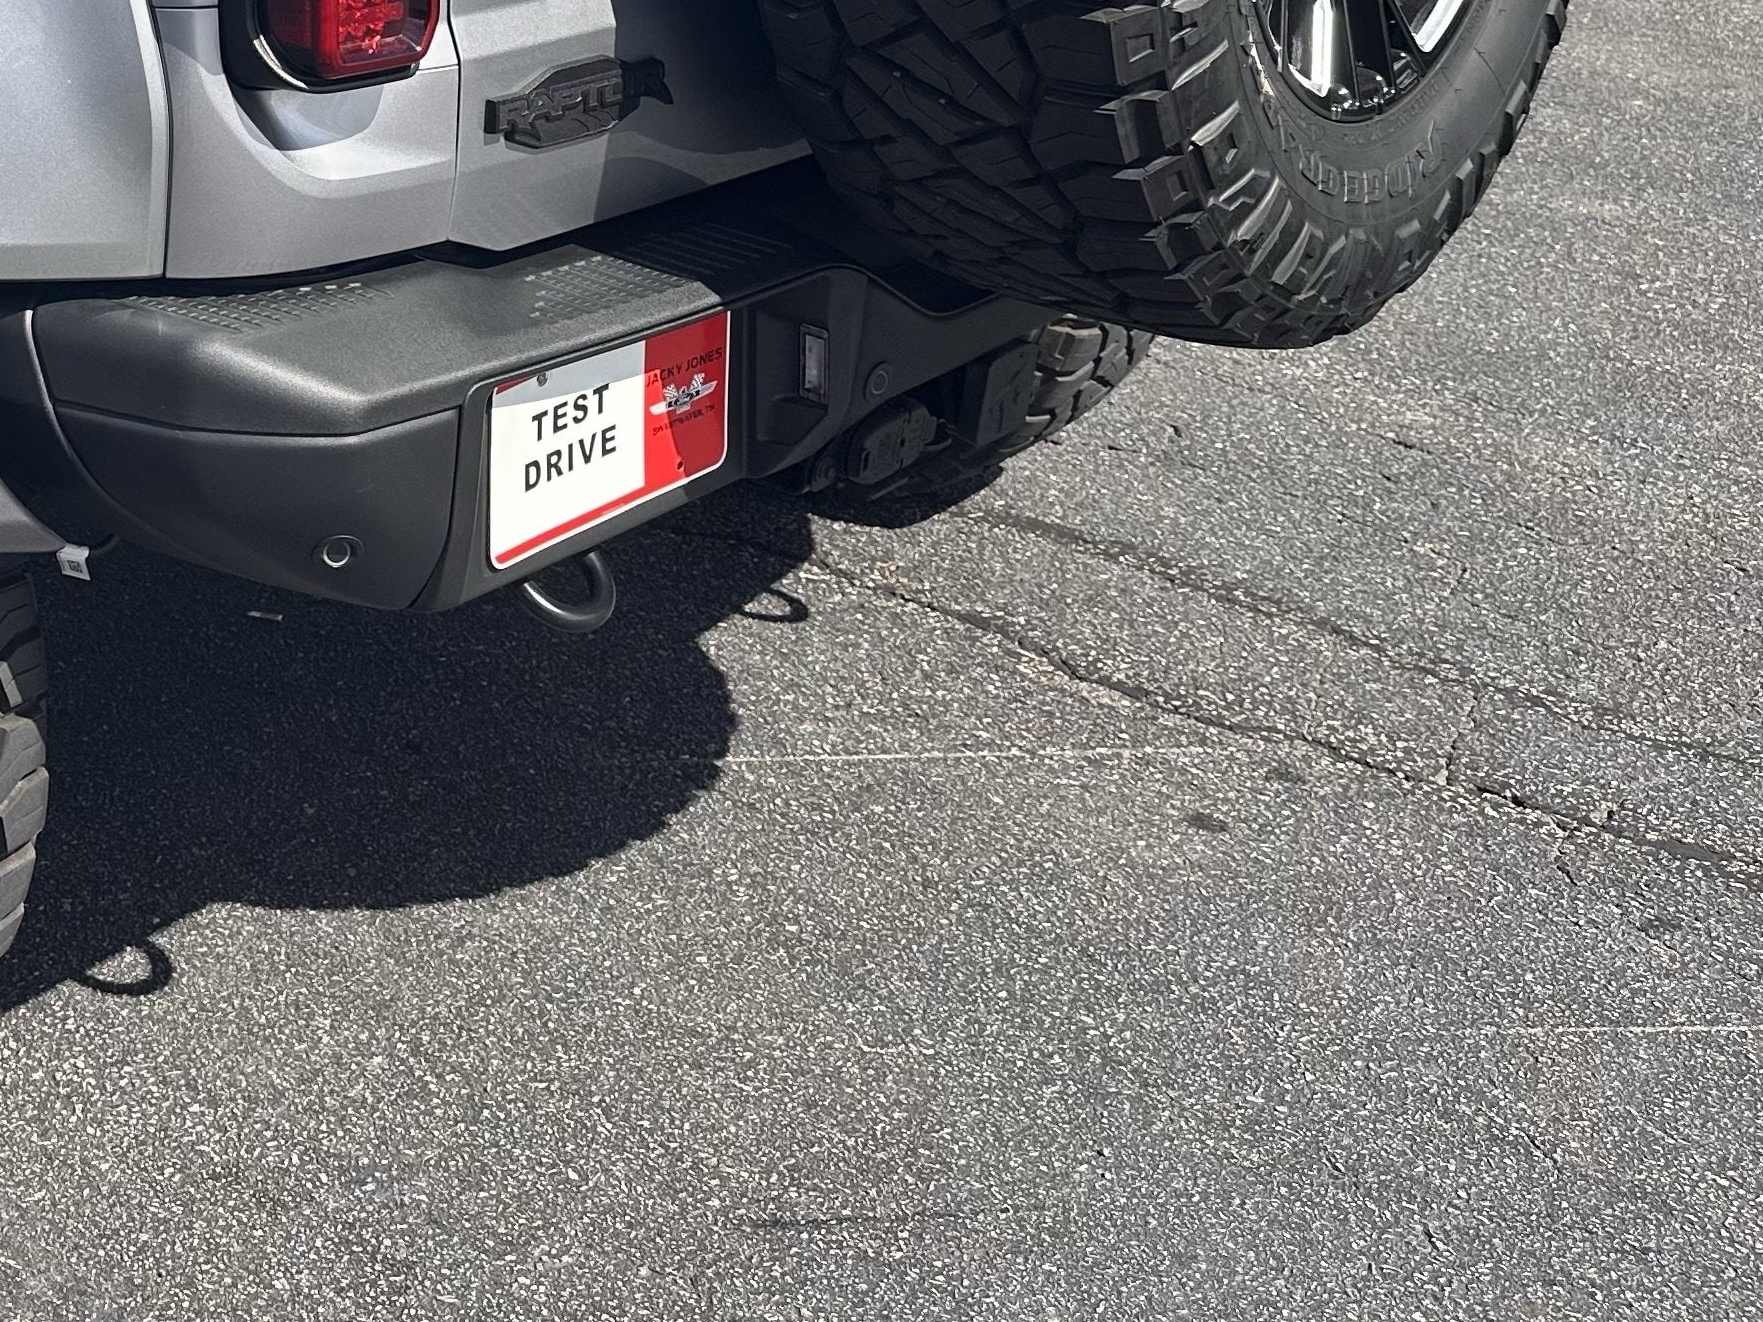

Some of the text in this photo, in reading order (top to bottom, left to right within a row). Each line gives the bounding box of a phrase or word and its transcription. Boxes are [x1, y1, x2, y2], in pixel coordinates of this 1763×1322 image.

[646, 346, 723, 387] JACKY JONES
[532, 383, 610, 442] TEST
[524, 424, 617, 493] DRIVE
